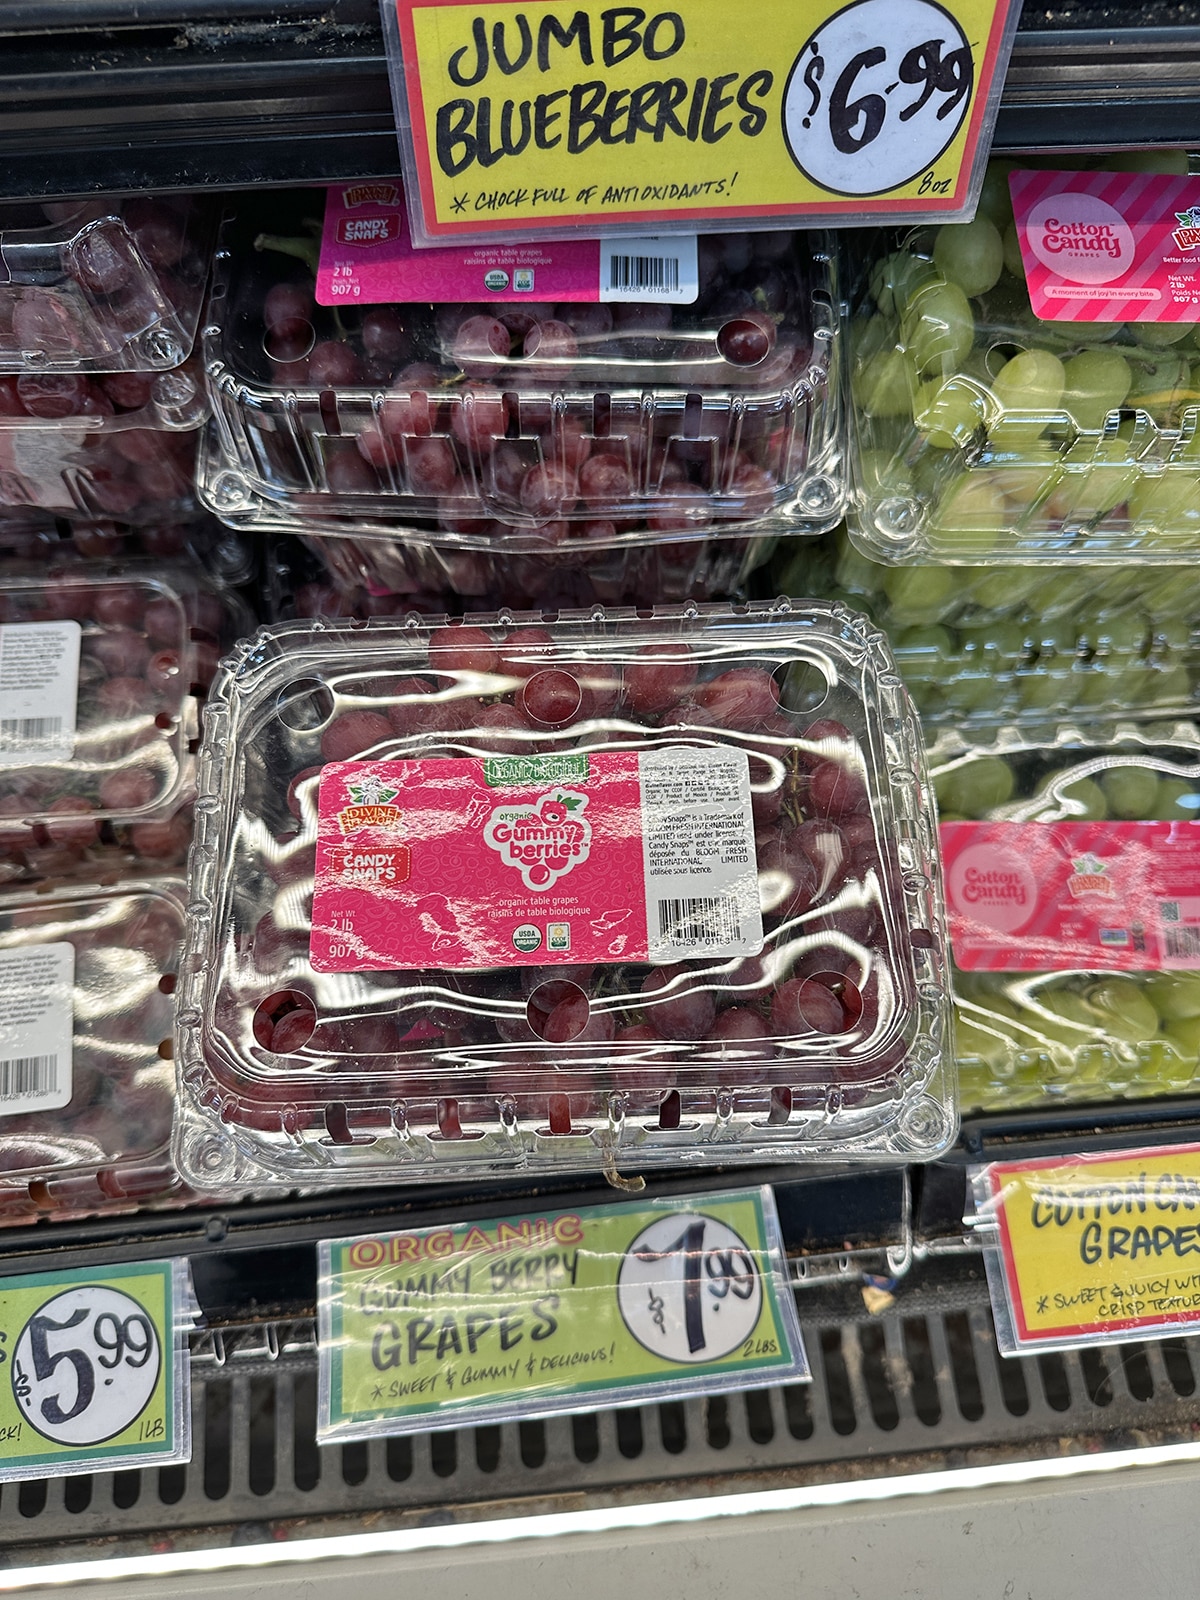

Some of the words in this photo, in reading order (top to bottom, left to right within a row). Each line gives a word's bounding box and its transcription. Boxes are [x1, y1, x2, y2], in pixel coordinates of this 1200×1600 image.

[447, 7, 685, 87] JUMBO
[802, 41, 979, 155] $6.99
[436, 70, 774, 178] BLUEBERRIES
[474, 188, 530, 212] CHOCK
[531, 187, 570, 206] FULL
[576, 184, 599, 205] OF
[601, 171, 739, 205] ANTIOXIDANTS!
[345, 219, 389, 231] CANDY
[1044, 218, 1113, 237] Cotton
[344, 229, 389, 241] SNAPS
[519, 249, 543, 257] grapes
[1042, 234, 1122, 259] Candy
[333, 267, 340, 277] 2
[342, 266, 353, 277] lb
[331, 285, 352, 296] 907
[353, 286, 361, 297] g
[1169, 281, 1176, 289] 2
[349, 807, 394, 818] DIVINE
[499, 812, 533, 822] organic
[493, 823, 577, 844] Gummy
[695, 831, 713, 839] under
[648, 842, 669, 850] Candy
[722, 838, 746, 847] marque
[696, 847, 720, 856] BLOOM
[726, 847, 748, 855] FRESH
[343, 854, 396, 868] CANDY
[649, 858, 703, 867] INTERNATIONAL
[721, 855, 749, 864] LIMITED
[342, 867, 397, 881] SNAPS
[965, 867, 1021, 884] Cotton
[499, 898, 528, 908] organic
[530, 896, 551, 905] table
[552, 896, 579, 906] grapes
[962, 883, 1026, 907] Candy
[487, 908, 514, 918] raisins
[515, 908, 526, 917] de
[527, 907, 548, 916] table
[549, 906, 591, 917] biologique
[342, 919, 354, 931] lb
[329, 945, 352, 958] 907
[350, 1213, 585, 1269] ORGANIC
[490, 1249, 580, 1293] BERRY
[1054, 1285, 1108, 1309] SWEET
[1123, 1277, 1170, 1299] JUICY
[1098, 1300, 1146, 1317] CRISP
[372, 1294, 560, 1372] GRAPES
[387, 1372, 443, 1398] SWEET
[460, 1358, 521, 1387] GUMMY
[540, 1342, 616, 1371] DELICIOUS!
